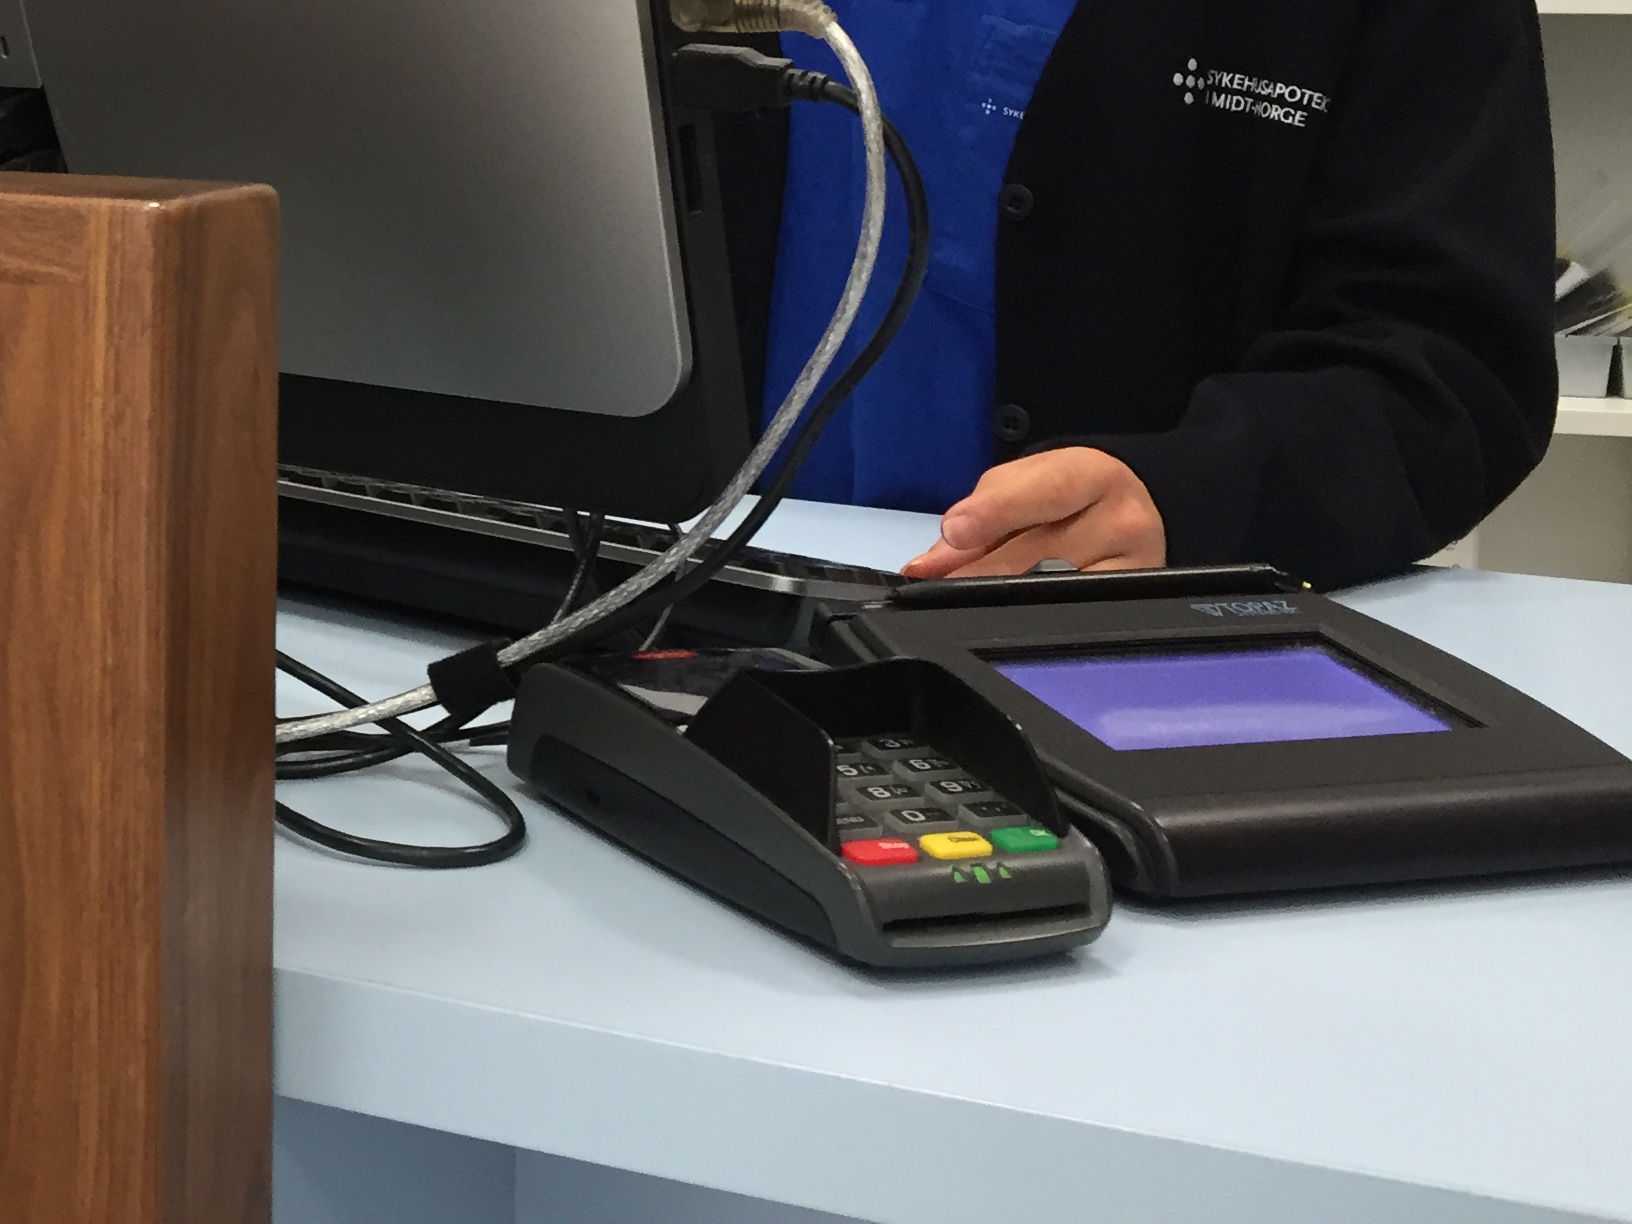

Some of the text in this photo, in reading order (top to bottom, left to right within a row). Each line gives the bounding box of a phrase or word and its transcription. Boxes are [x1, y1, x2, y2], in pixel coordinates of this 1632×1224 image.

[909, 759, 932, 769] 6
[836, 764, 859, 776] 5
[940, 781, 963, 792] 9
[867, 787, 891, 798] 8
[901, 810, 926, 821] 0
